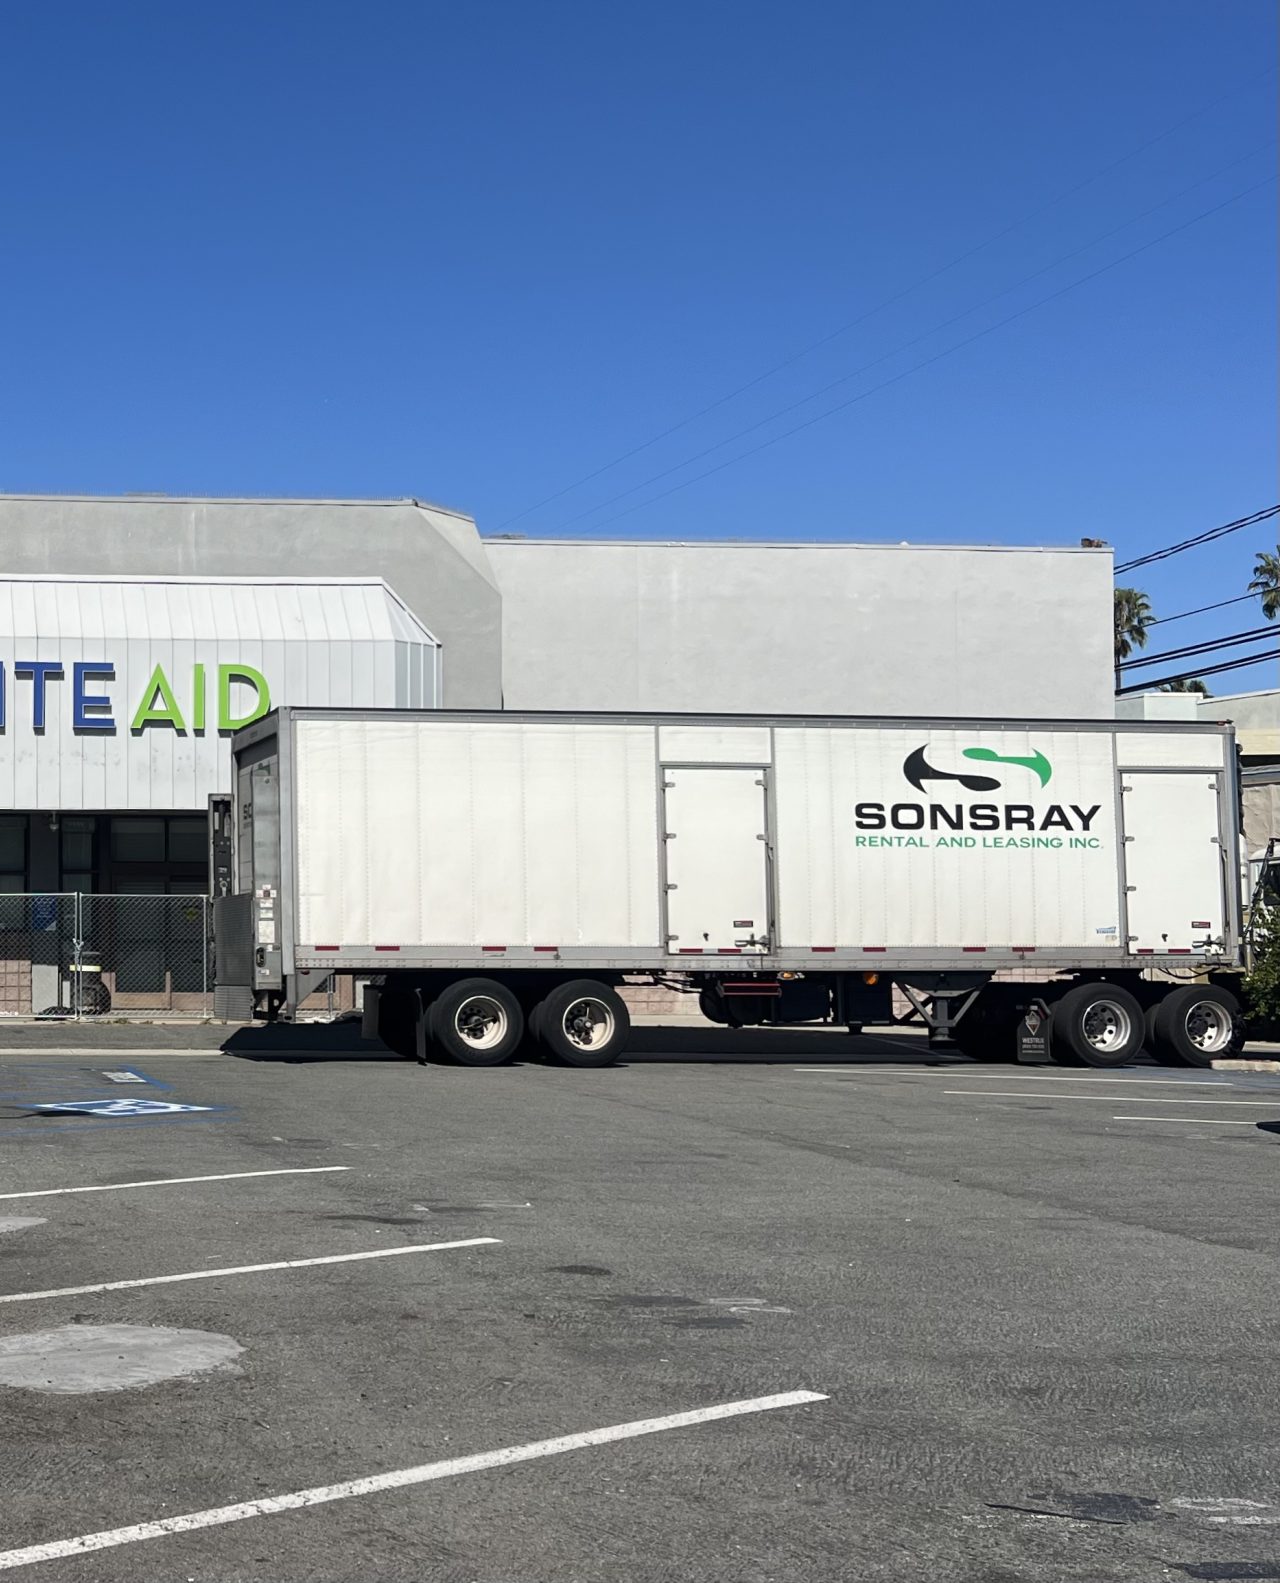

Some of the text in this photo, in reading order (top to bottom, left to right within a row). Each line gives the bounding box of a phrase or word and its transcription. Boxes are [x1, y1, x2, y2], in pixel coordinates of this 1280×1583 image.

[131, 663, 271, 731] AID
[855, 803, 1102, 832] SONSRAY
[855, 836, 1104, 849] RENTAL AND LEASING INC.
